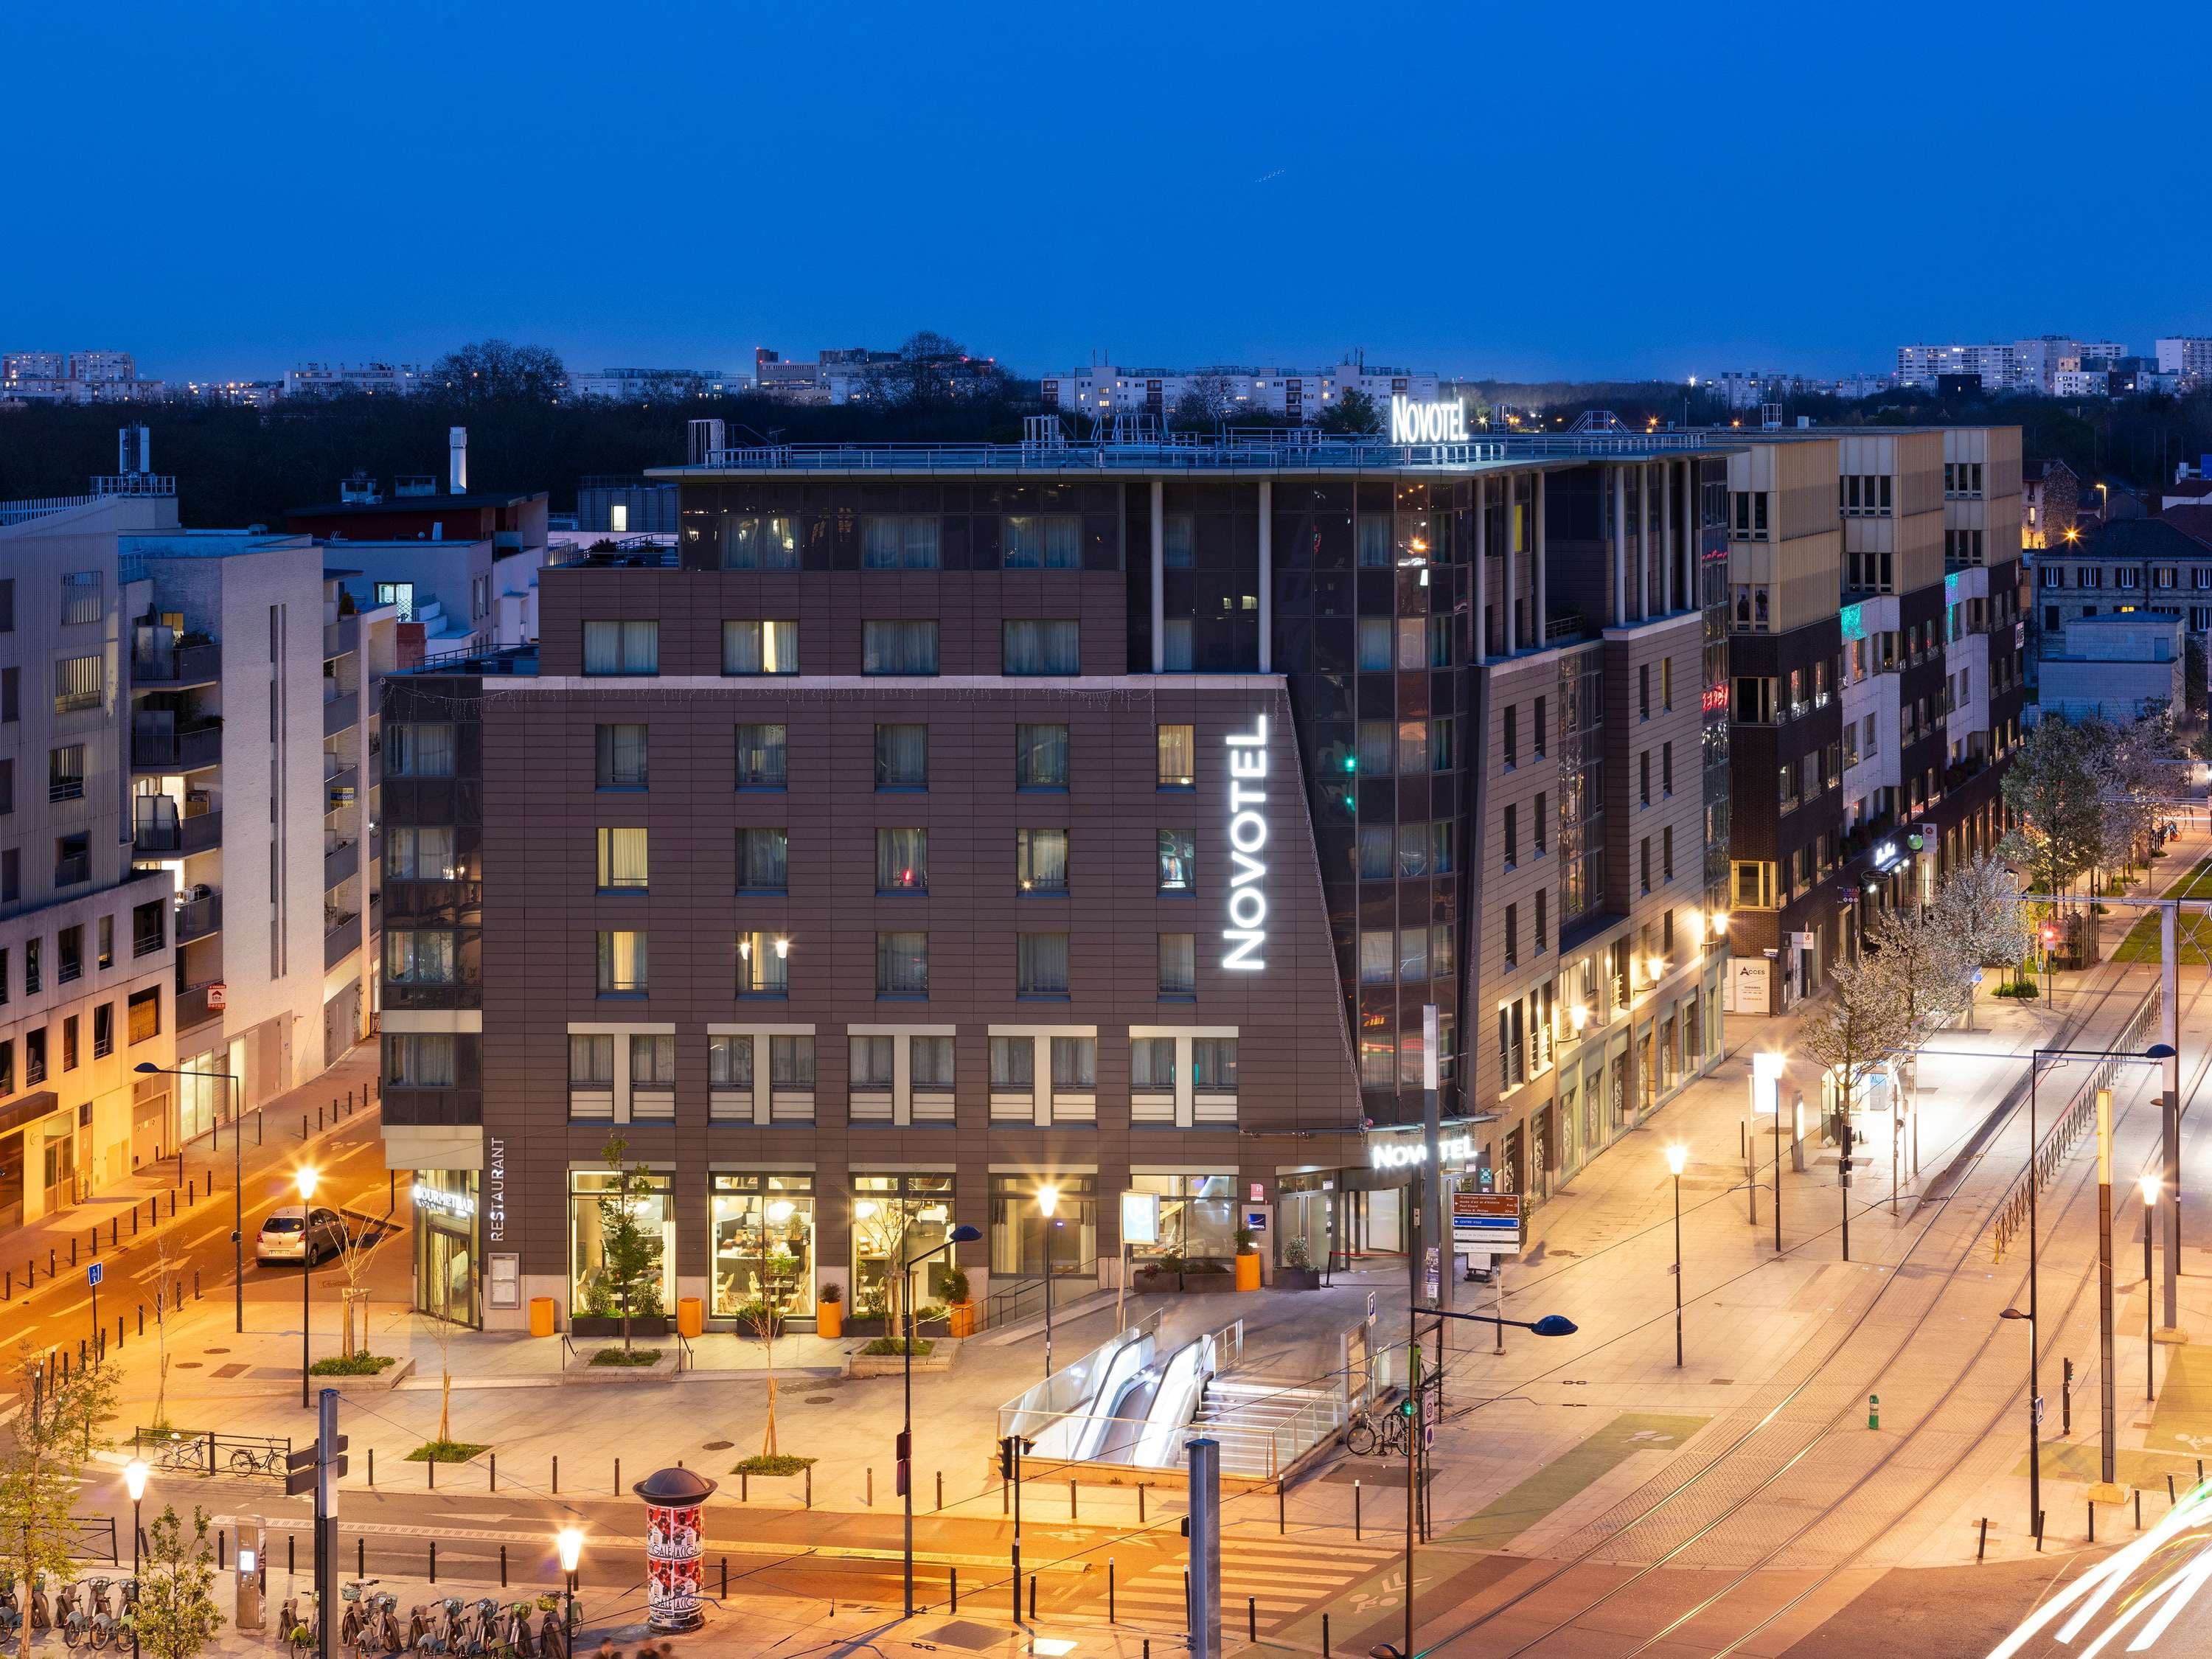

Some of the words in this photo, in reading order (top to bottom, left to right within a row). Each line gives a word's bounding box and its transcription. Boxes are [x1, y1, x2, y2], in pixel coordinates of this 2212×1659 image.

[1392, 396, 1470, 443] NOVOTEL
[1222, 714, 1266, 970] NOVOTEL
[491, 1138, 504, 1241] RESTAURANT
[1374, 1135, 1478, 1169] NOVTEL
